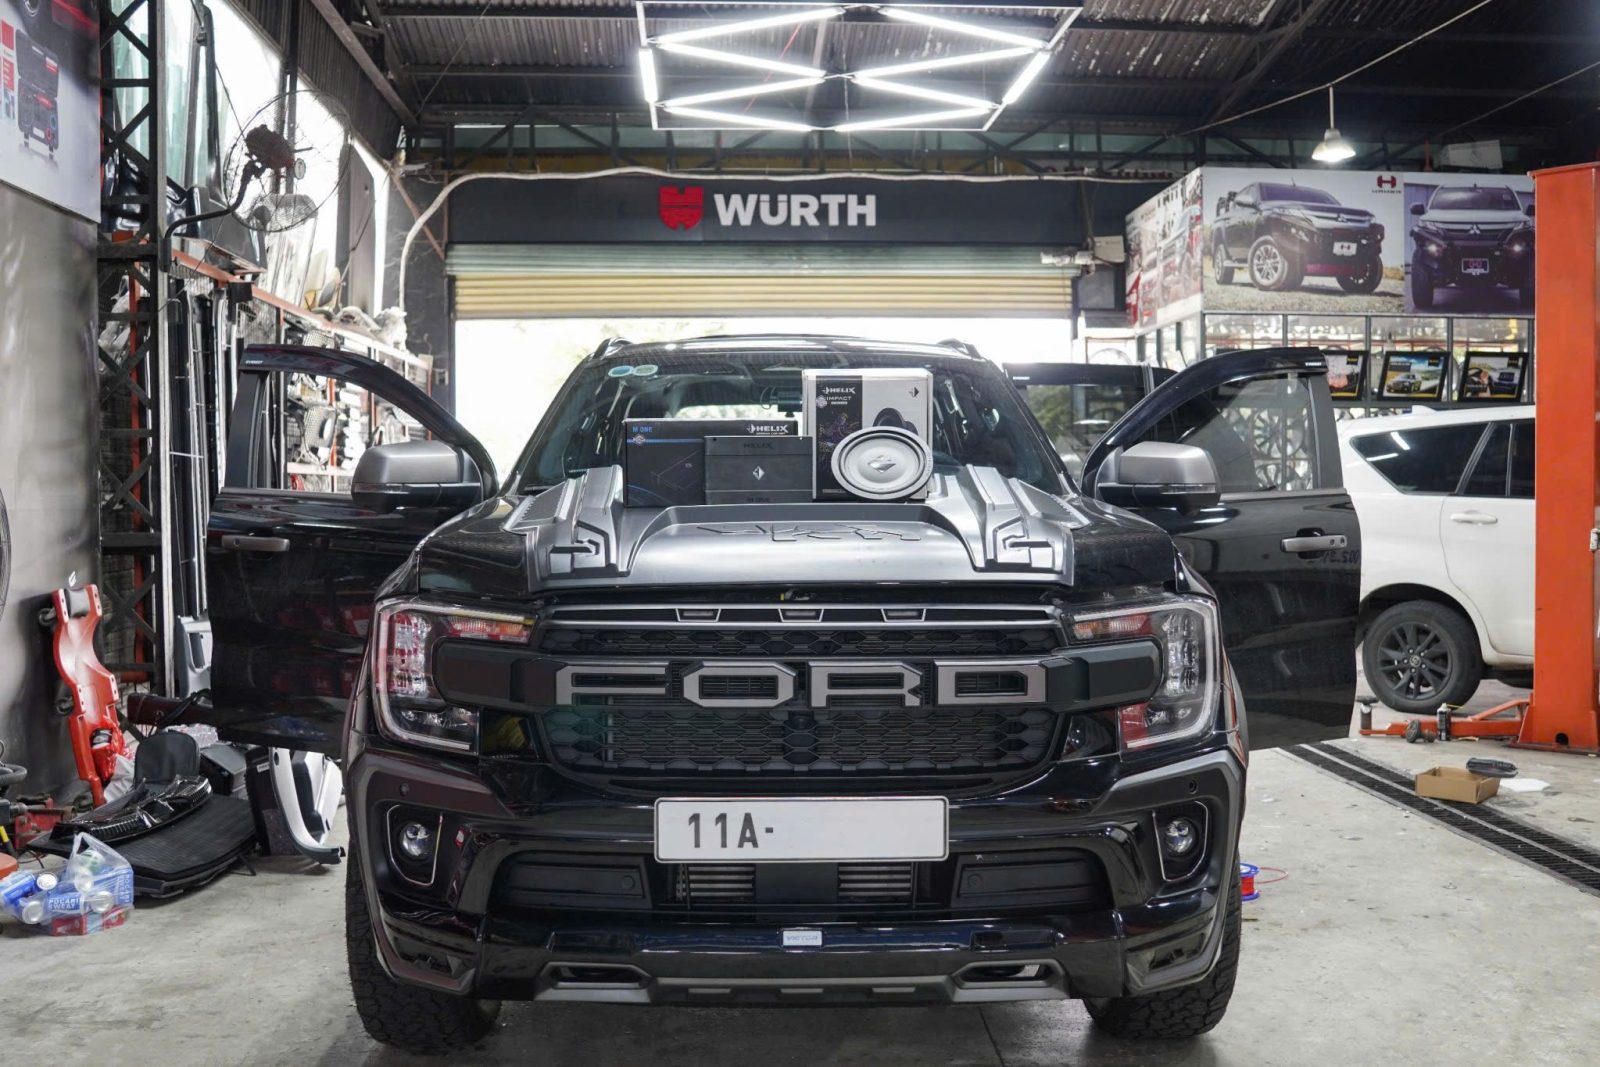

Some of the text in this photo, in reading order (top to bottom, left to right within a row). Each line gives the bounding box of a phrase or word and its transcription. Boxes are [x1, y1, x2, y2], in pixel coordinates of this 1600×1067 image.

[713, 193, 877, 226] WÜRTH
[756, 425, 789, 433] HELIX
[555, 660, 1047, 708] FORD
